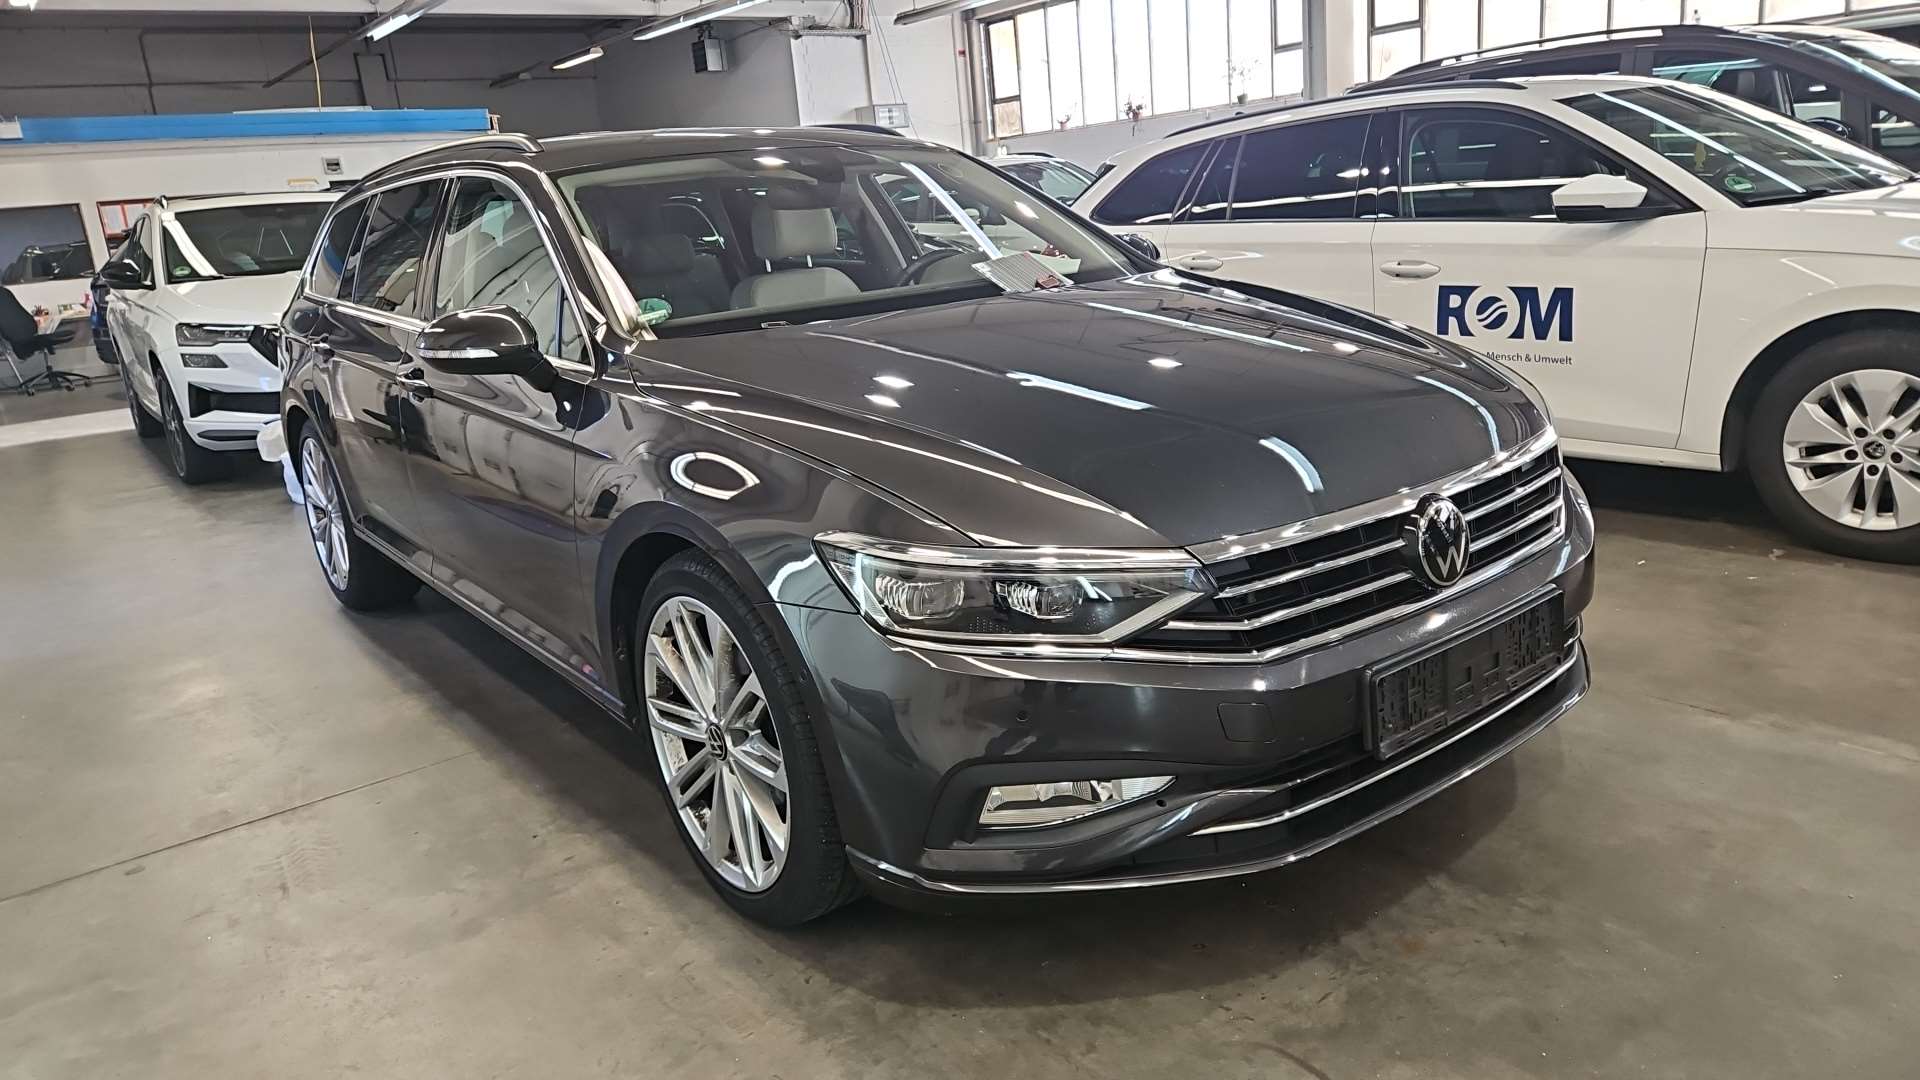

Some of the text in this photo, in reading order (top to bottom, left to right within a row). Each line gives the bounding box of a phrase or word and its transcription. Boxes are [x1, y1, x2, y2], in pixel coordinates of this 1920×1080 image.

[1436, 285, 1574, 342] ROM
[1486, 351, 1573, 365] Mensch & Umwelt
